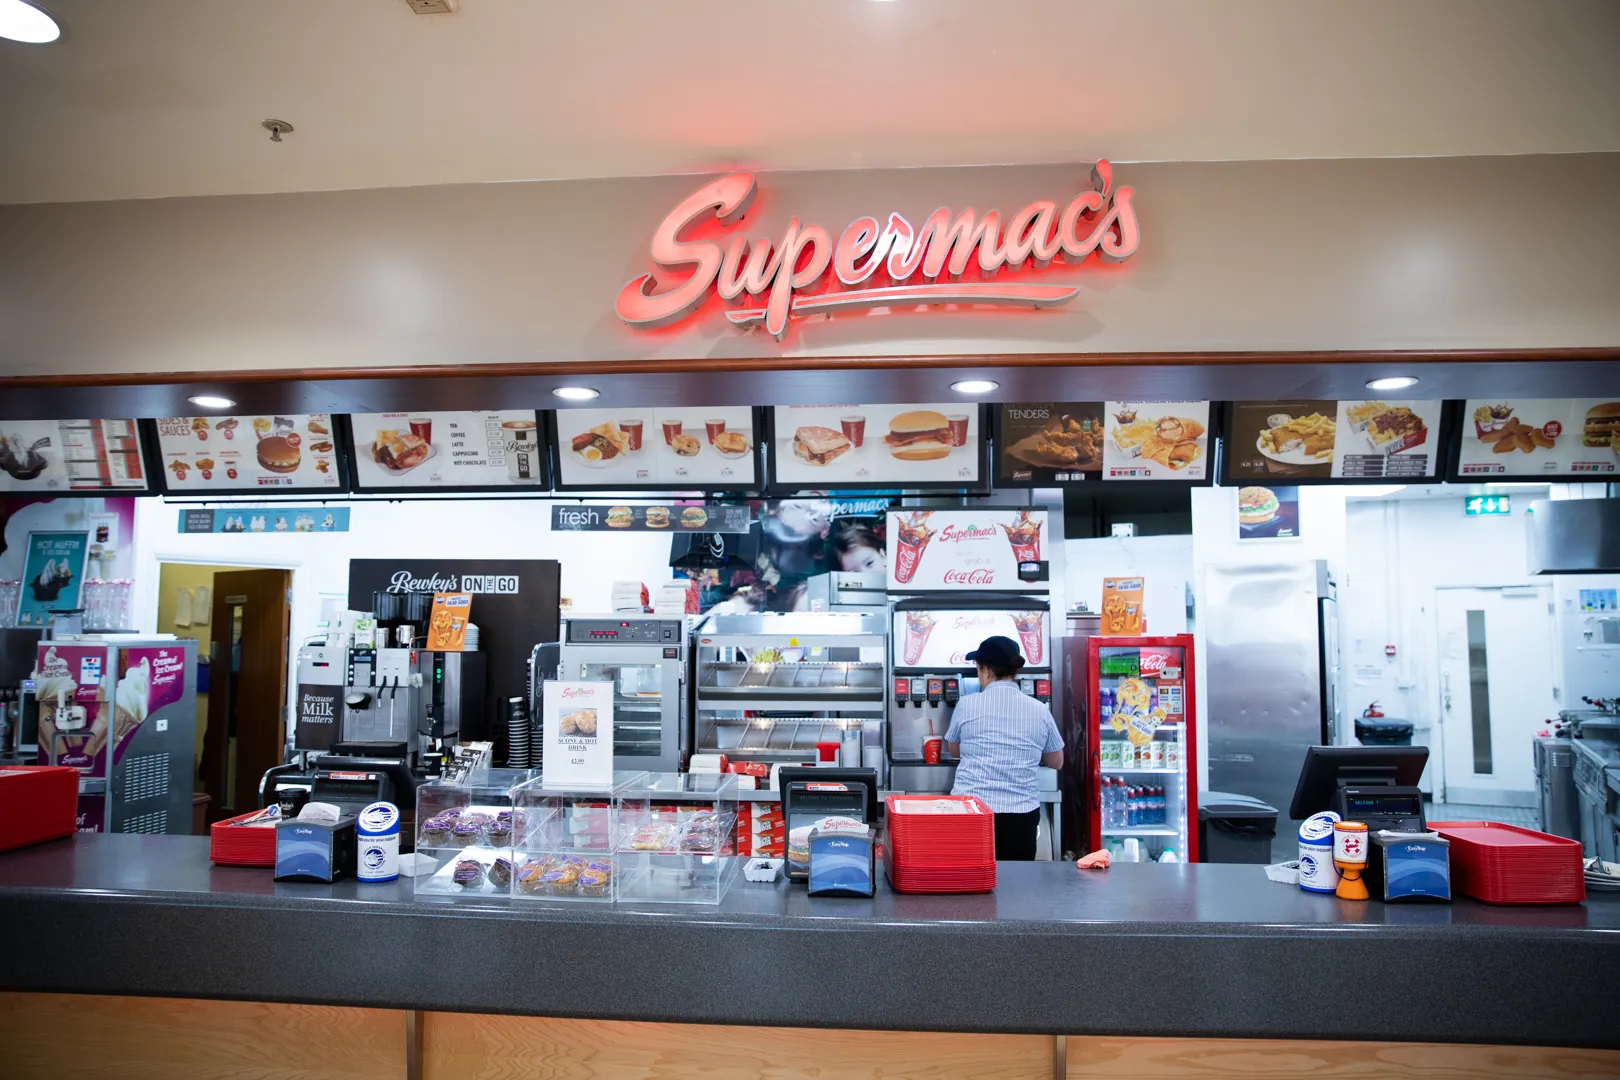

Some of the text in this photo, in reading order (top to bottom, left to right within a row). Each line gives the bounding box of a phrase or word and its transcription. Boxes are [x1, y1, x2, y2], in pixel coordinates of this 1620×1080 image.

[615, 158, 1141, 341] Supermac's
[1008, 409, 1050, 419] TENDERS
[160, 426, 191, 436] SAUCES
[559, 508, 599, 525] fresh
[939, 524, 997, 543] Supermac's
[37, 540, 53, 549] HOT
[386, 571, 516, 594] Bewley's ON THE GO
[943, 568, 996, 584] Coca-Cola
[304, 694, 334, 702] Because
[303, 702, 334, 716] Milk
[302, 716, 333, 724] matters
[76, 813, 87, 825] of
